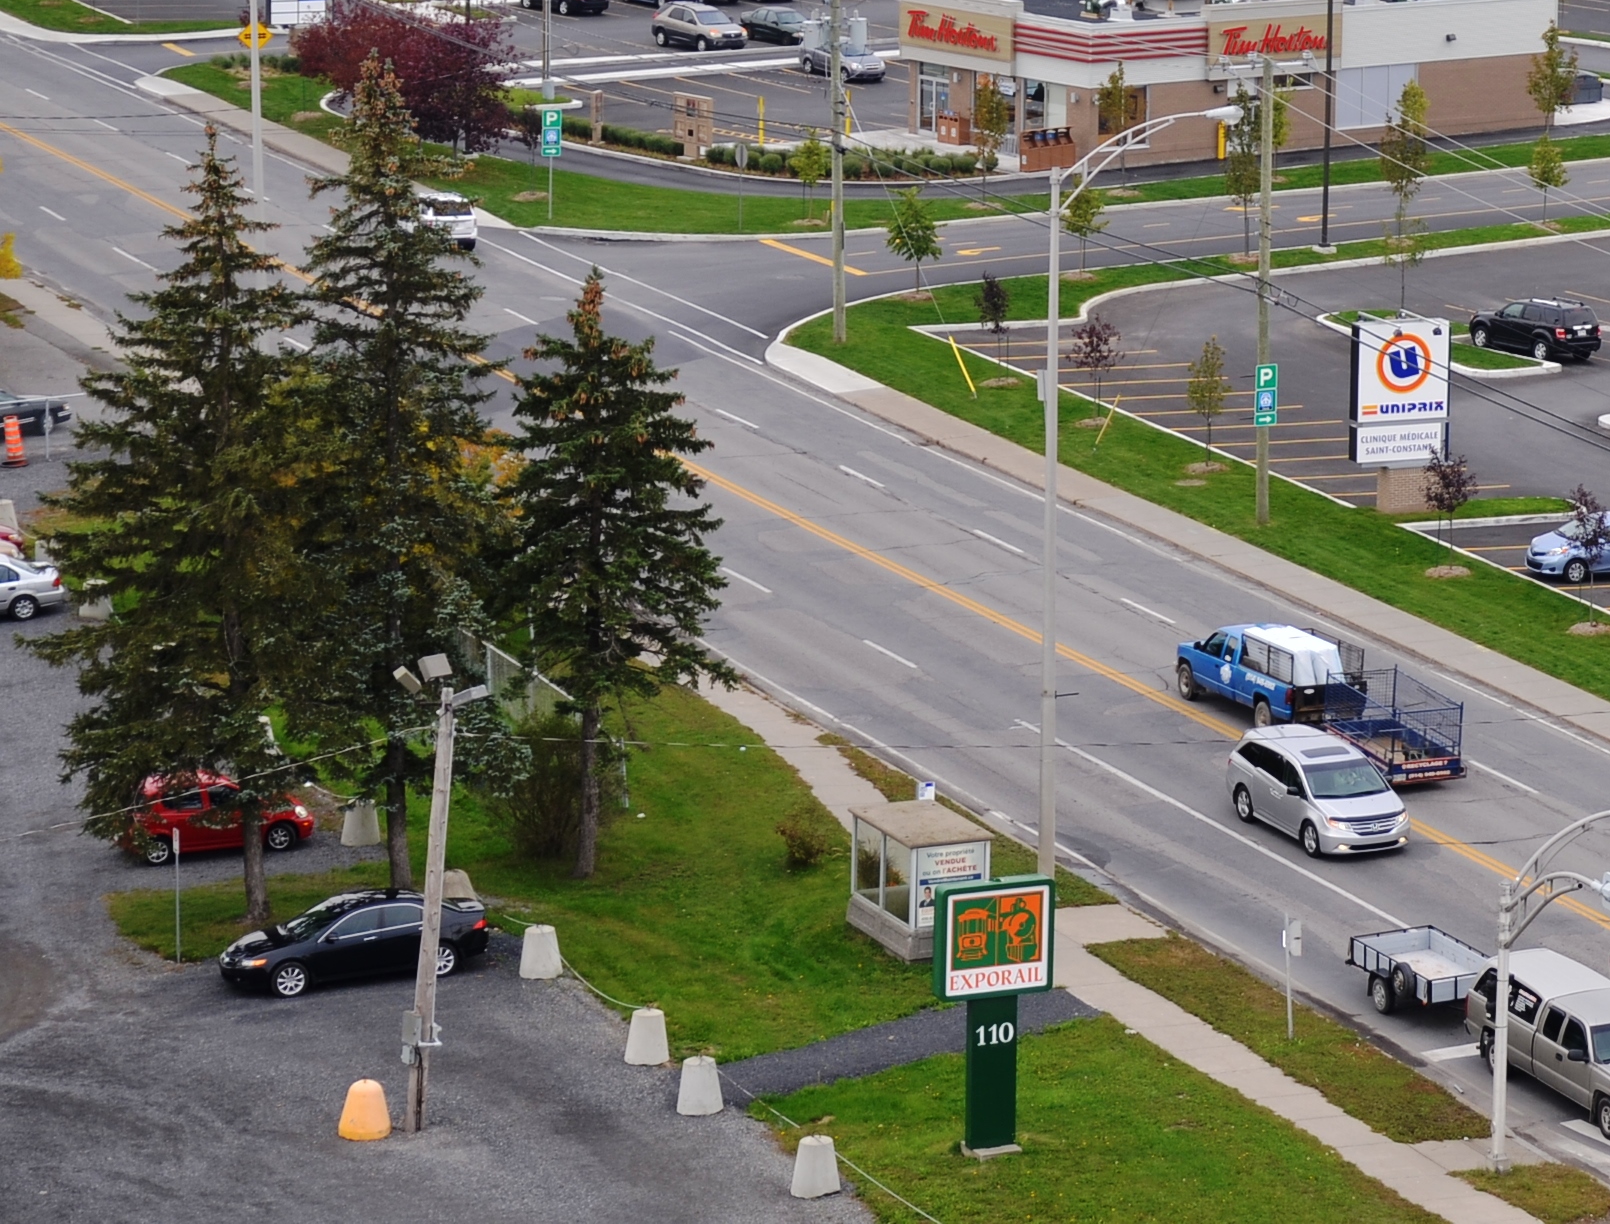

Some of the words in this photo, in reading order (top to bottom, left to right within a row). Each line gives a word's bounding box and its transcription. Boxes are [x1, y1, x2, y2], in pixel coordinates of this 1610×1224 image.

[907, 10, 937, 42] Tim
[937, 13, 997, 52] Hortons
[1222, 26, 1258, 55] Tim
[1260, 23, 1328, 53] Horton
[546, 111, 558, 126] P
[1260, 368, 1273, 387] P
[1361, 433, 1397, 444] CLINIQUE
[1400, 431, 1438, 441] MÉDICALE
[935, 857, 967, 866] VENDUE
[945, 848, 975, 857] propriété
[950, 966, 1043, 991] EXPORAIL
[975, 1022, 1015, 1046] 110
